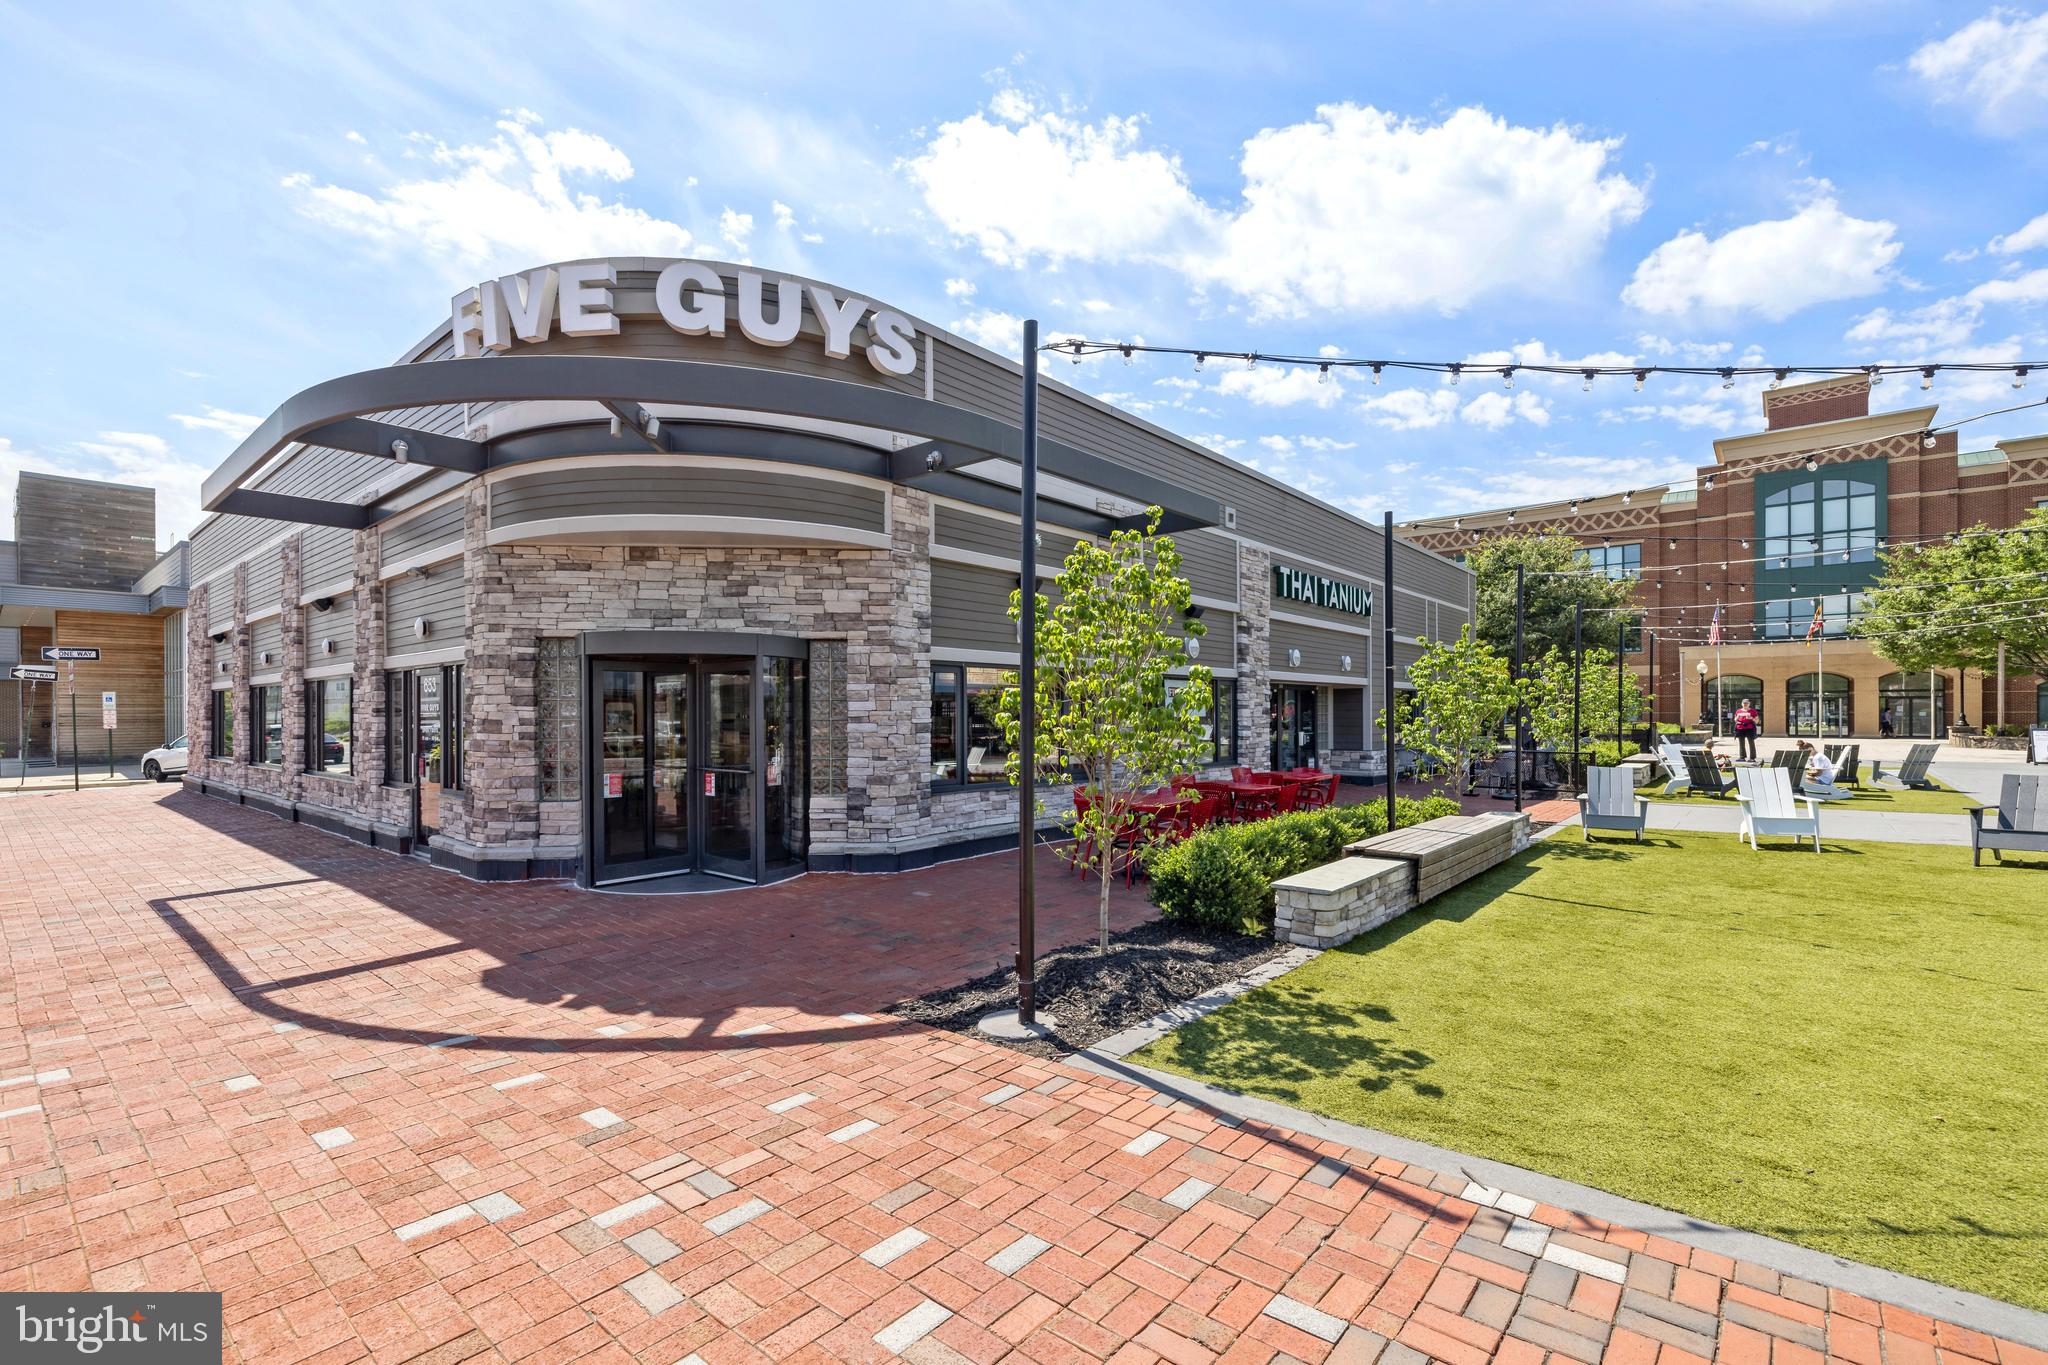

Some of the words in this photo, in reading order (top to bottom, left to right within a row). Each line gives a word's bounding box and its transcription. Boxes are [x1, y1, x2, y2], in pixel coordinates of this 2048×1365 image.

[451, 263, 620, 358] FIVE
[655, 262, 917, 376] GUYS
[1279, 566, 1318, 604] THAI
[1321, 578, 1373, 617] TANIUM
[59, 650, 75, 658] ONE
[77, 650, 93, 658] WAY
